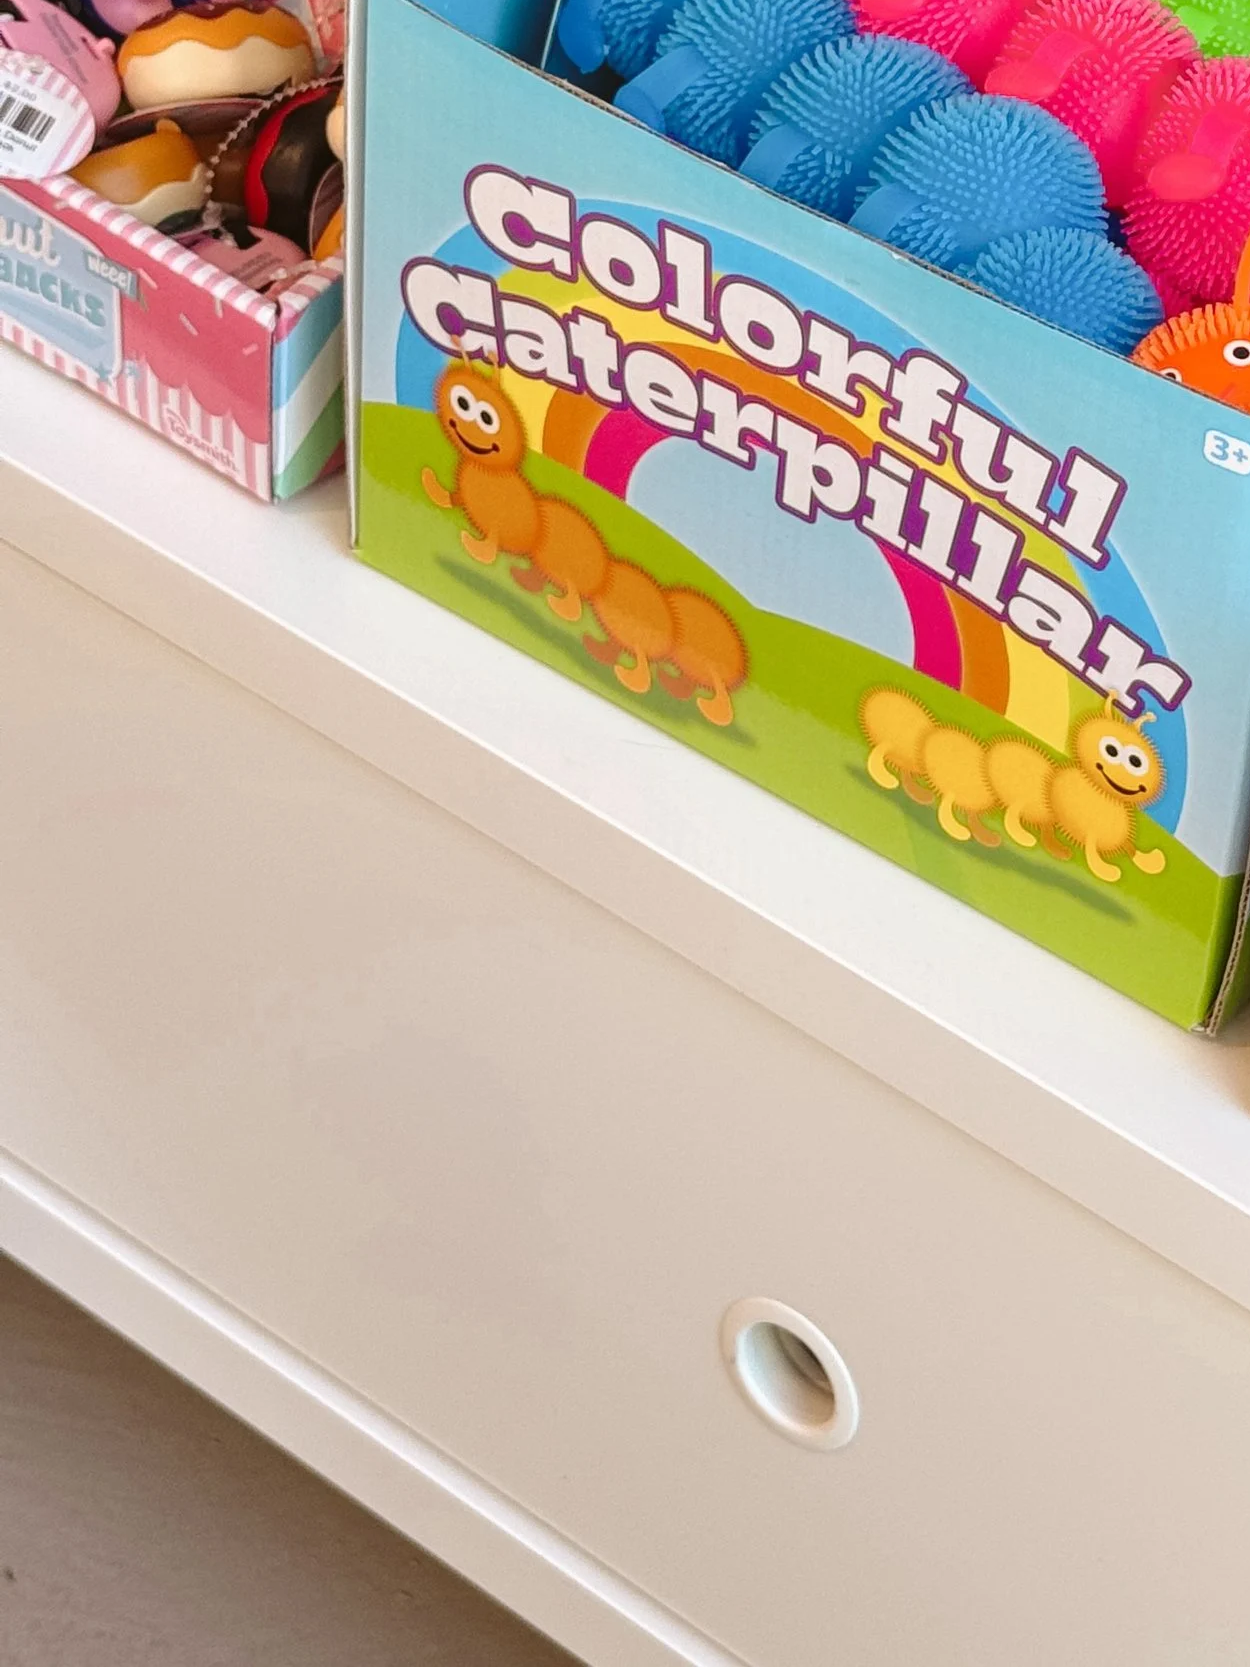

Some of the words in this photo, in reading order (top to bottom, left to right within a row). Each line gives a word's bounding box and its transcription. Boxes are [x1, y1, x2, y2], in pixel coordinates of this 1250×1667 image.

[401, 258, 1191, 712] Caterpillar
[464, 165, 1127, 569] Colorful
[1210, 435, 1249, 463] 3+
